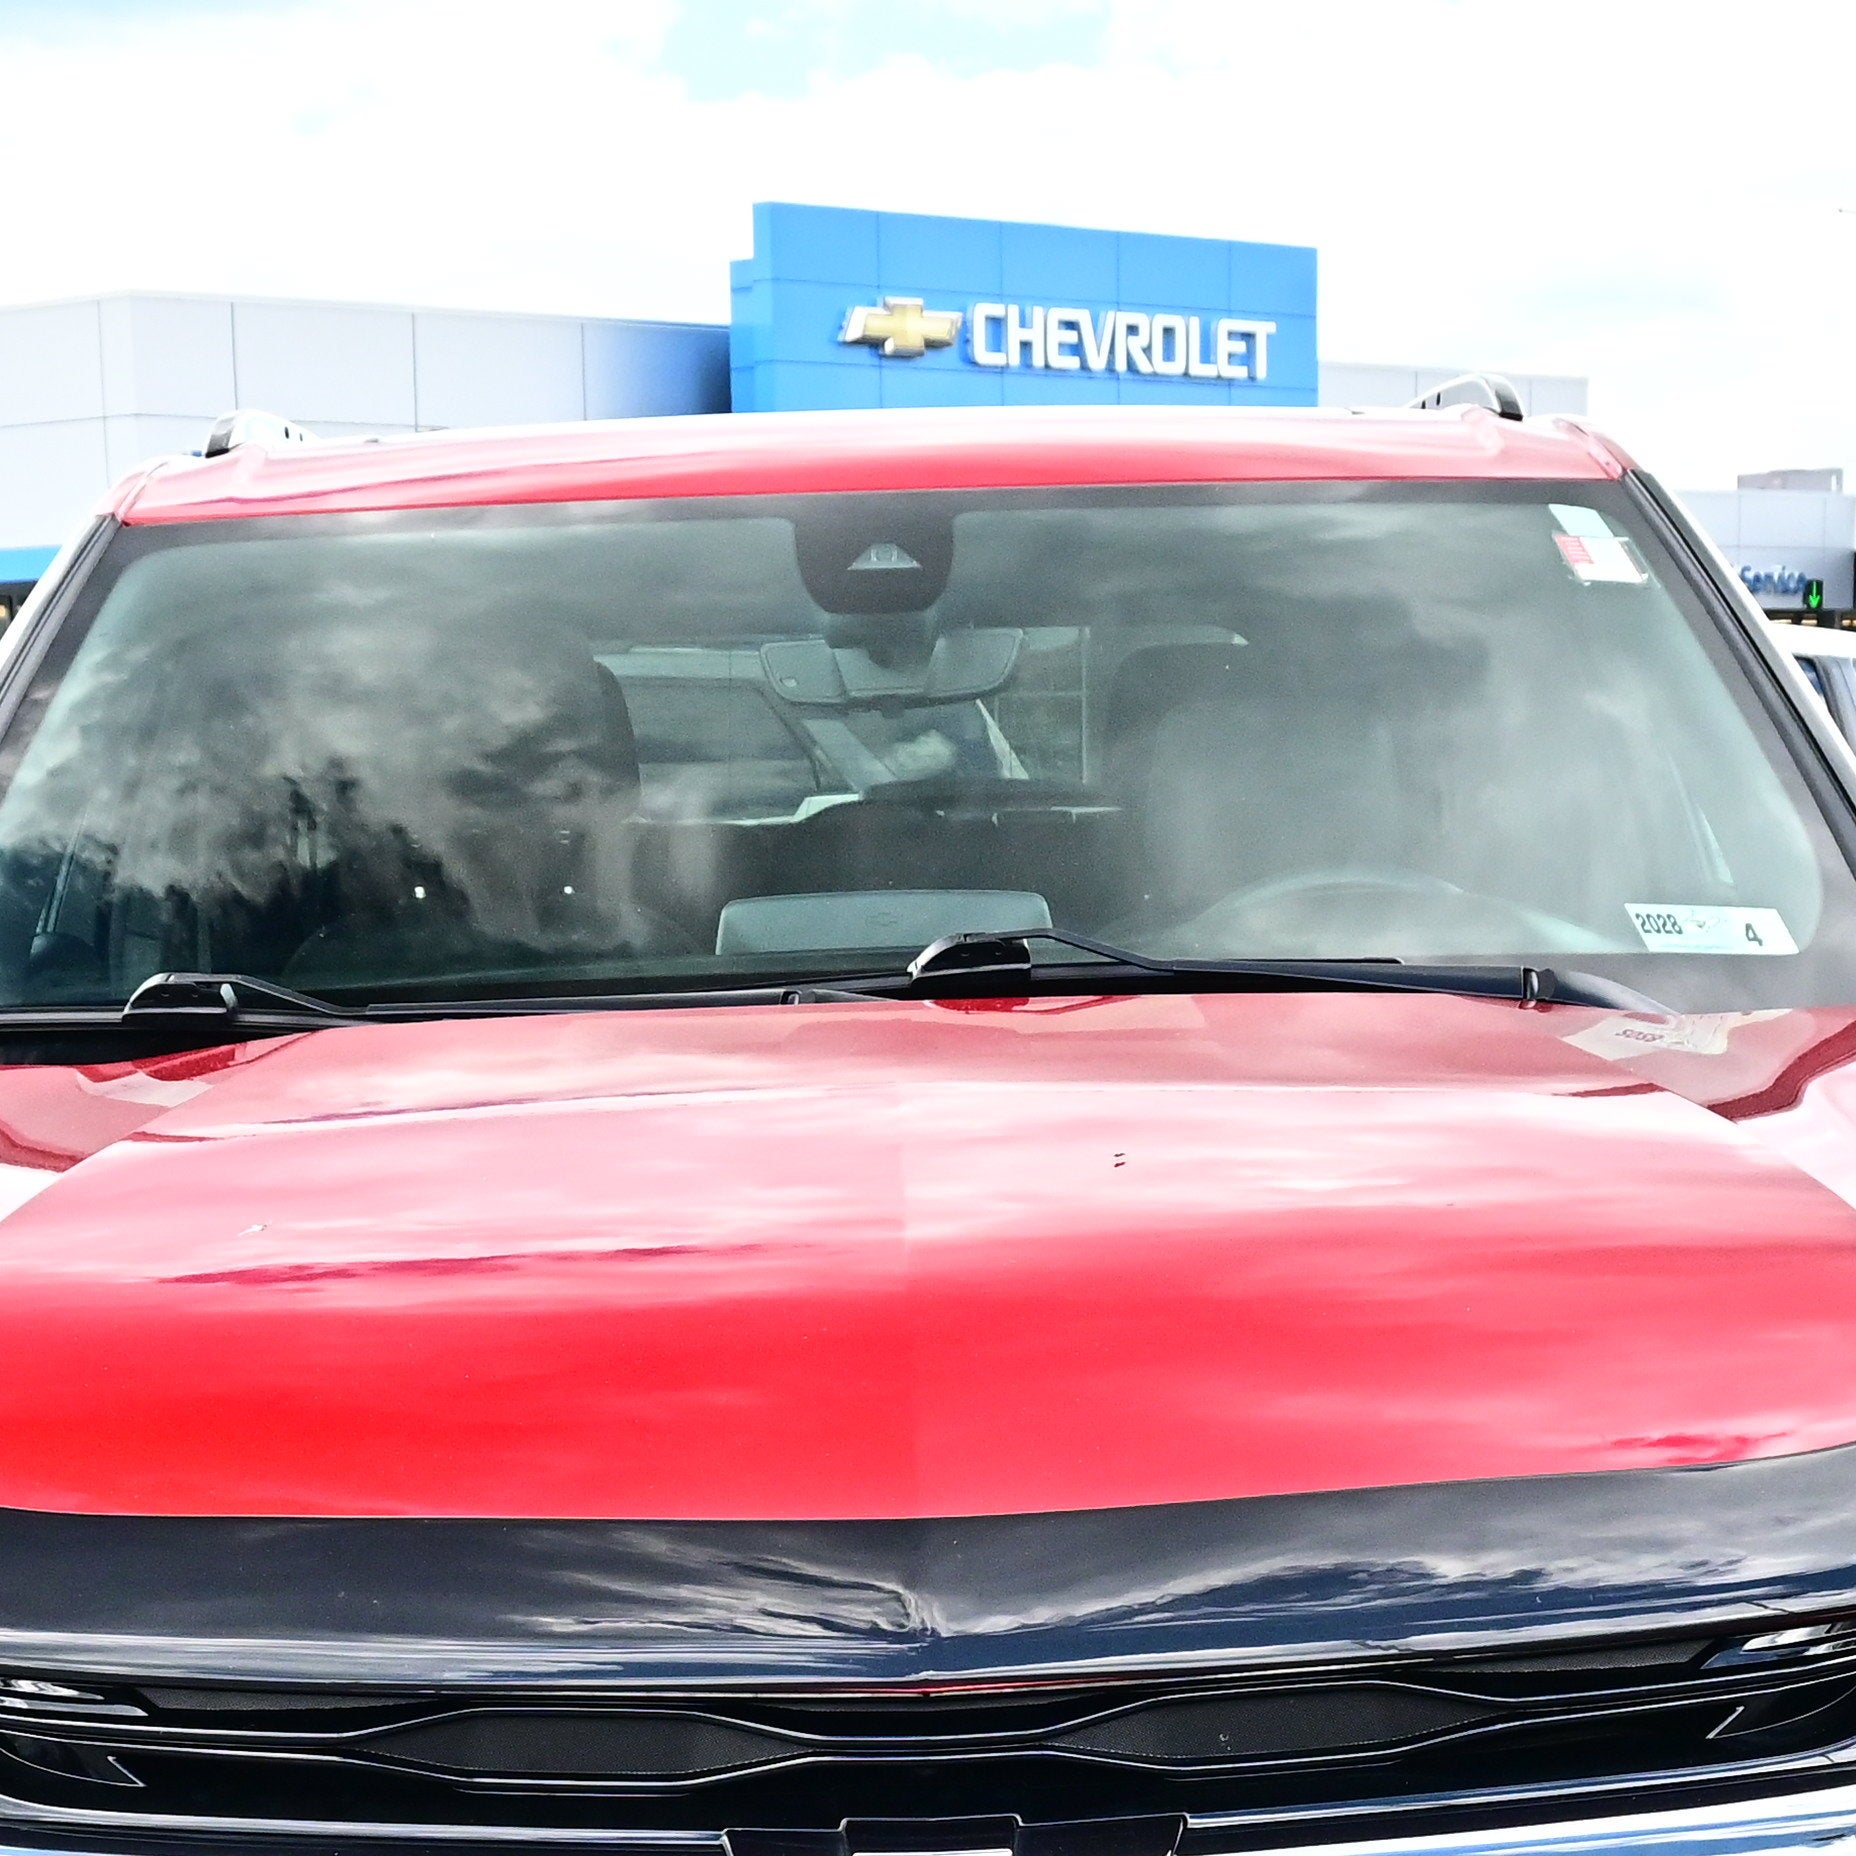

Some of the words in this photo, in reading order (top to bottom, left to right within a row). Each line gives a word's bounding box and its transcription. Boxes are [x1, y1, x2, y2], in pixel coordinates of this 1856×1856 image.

[970, 301, 1277, 380] CHEVROLET
[1635, 912, 1684, 935] 2028
[1744, 922, 1764, 947] 4
